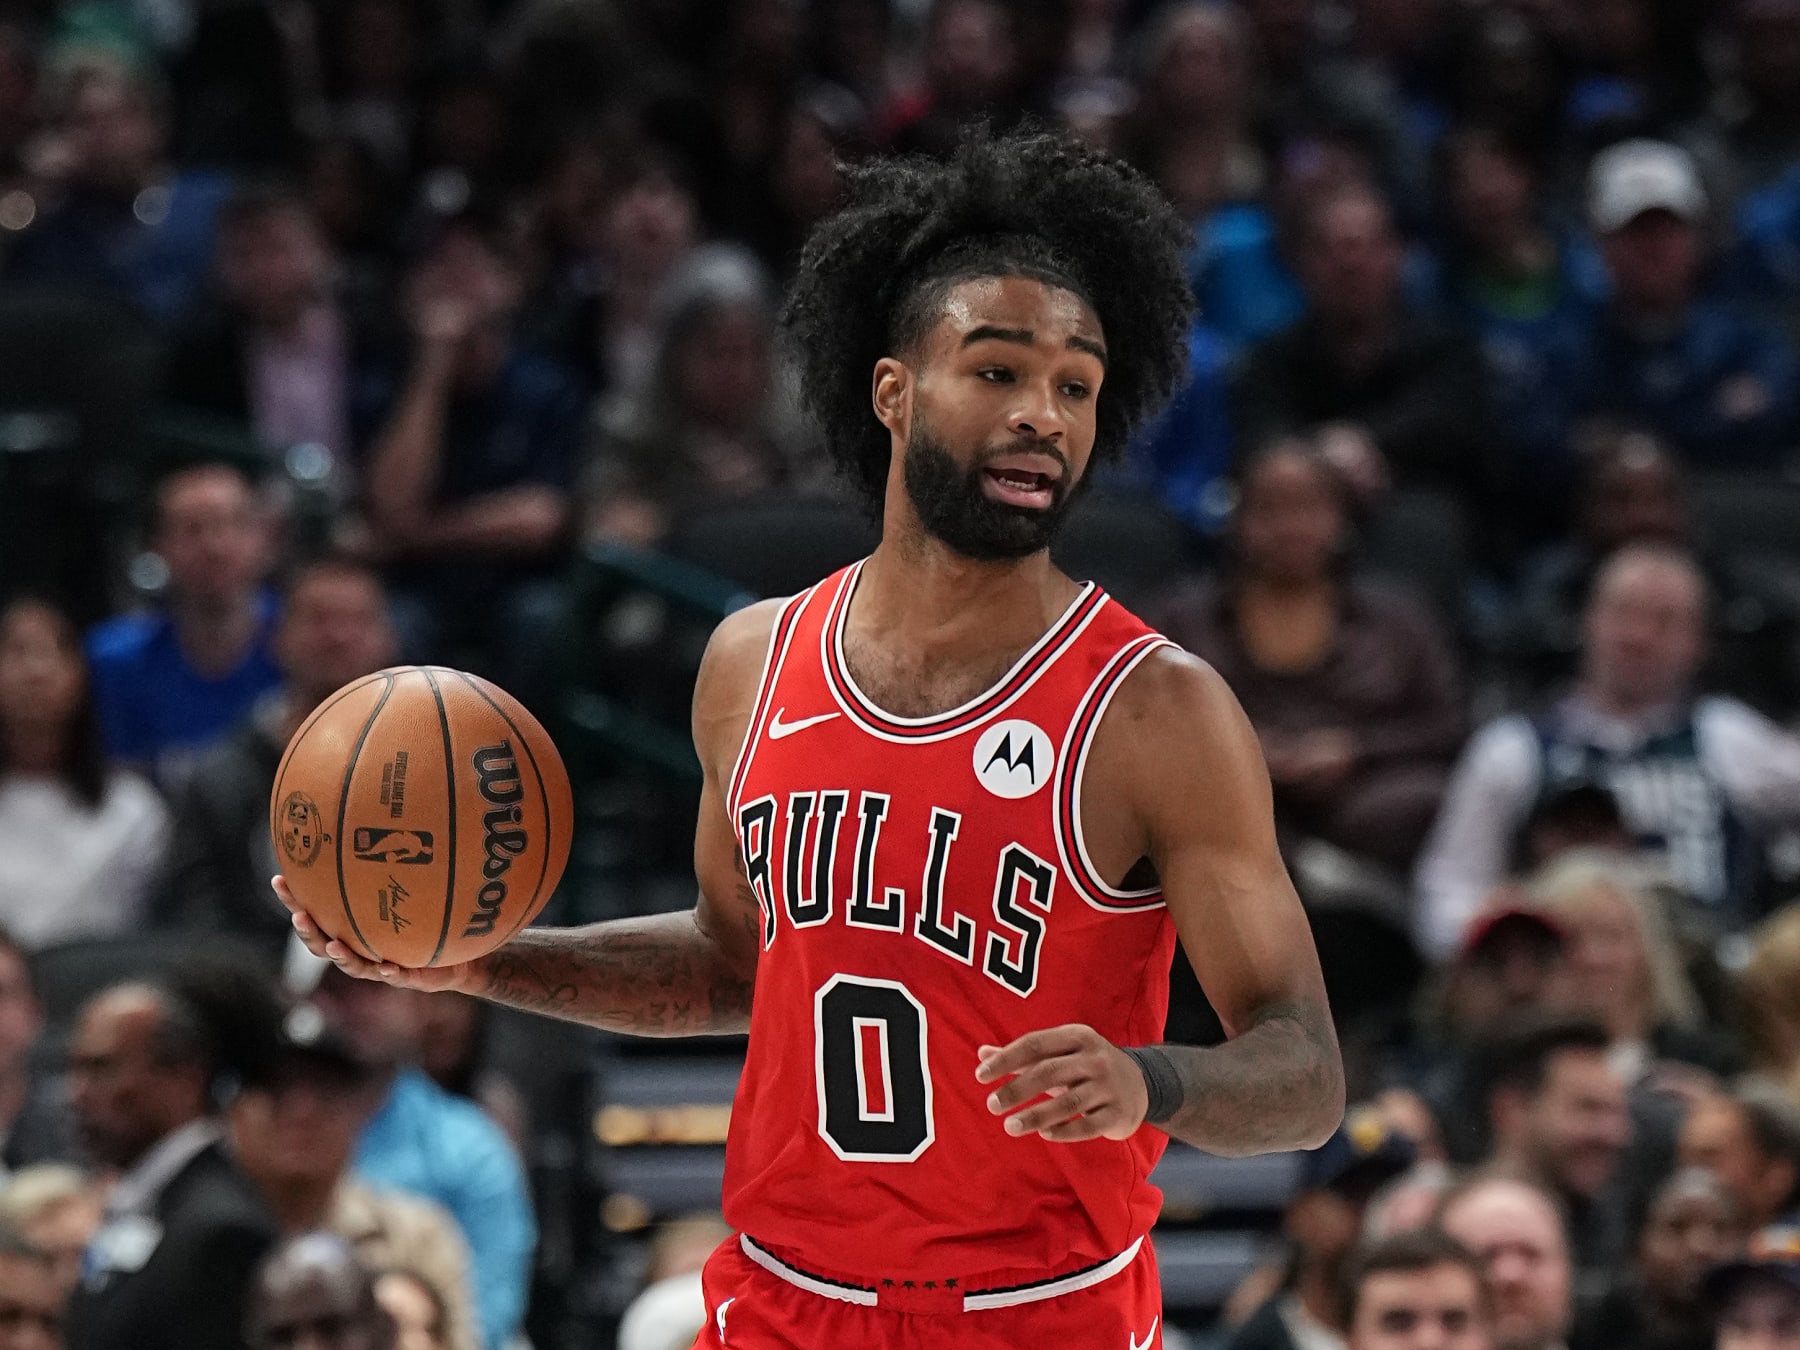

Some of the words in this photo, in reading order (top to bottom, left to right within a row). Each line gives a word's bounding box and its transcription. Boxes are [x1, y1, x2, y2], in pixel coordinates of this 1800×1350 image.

[463, 738, 528, 937] Wilson
[738, 790, 1057, 998] BULLS
[815, 973, 935, 1162] 0
